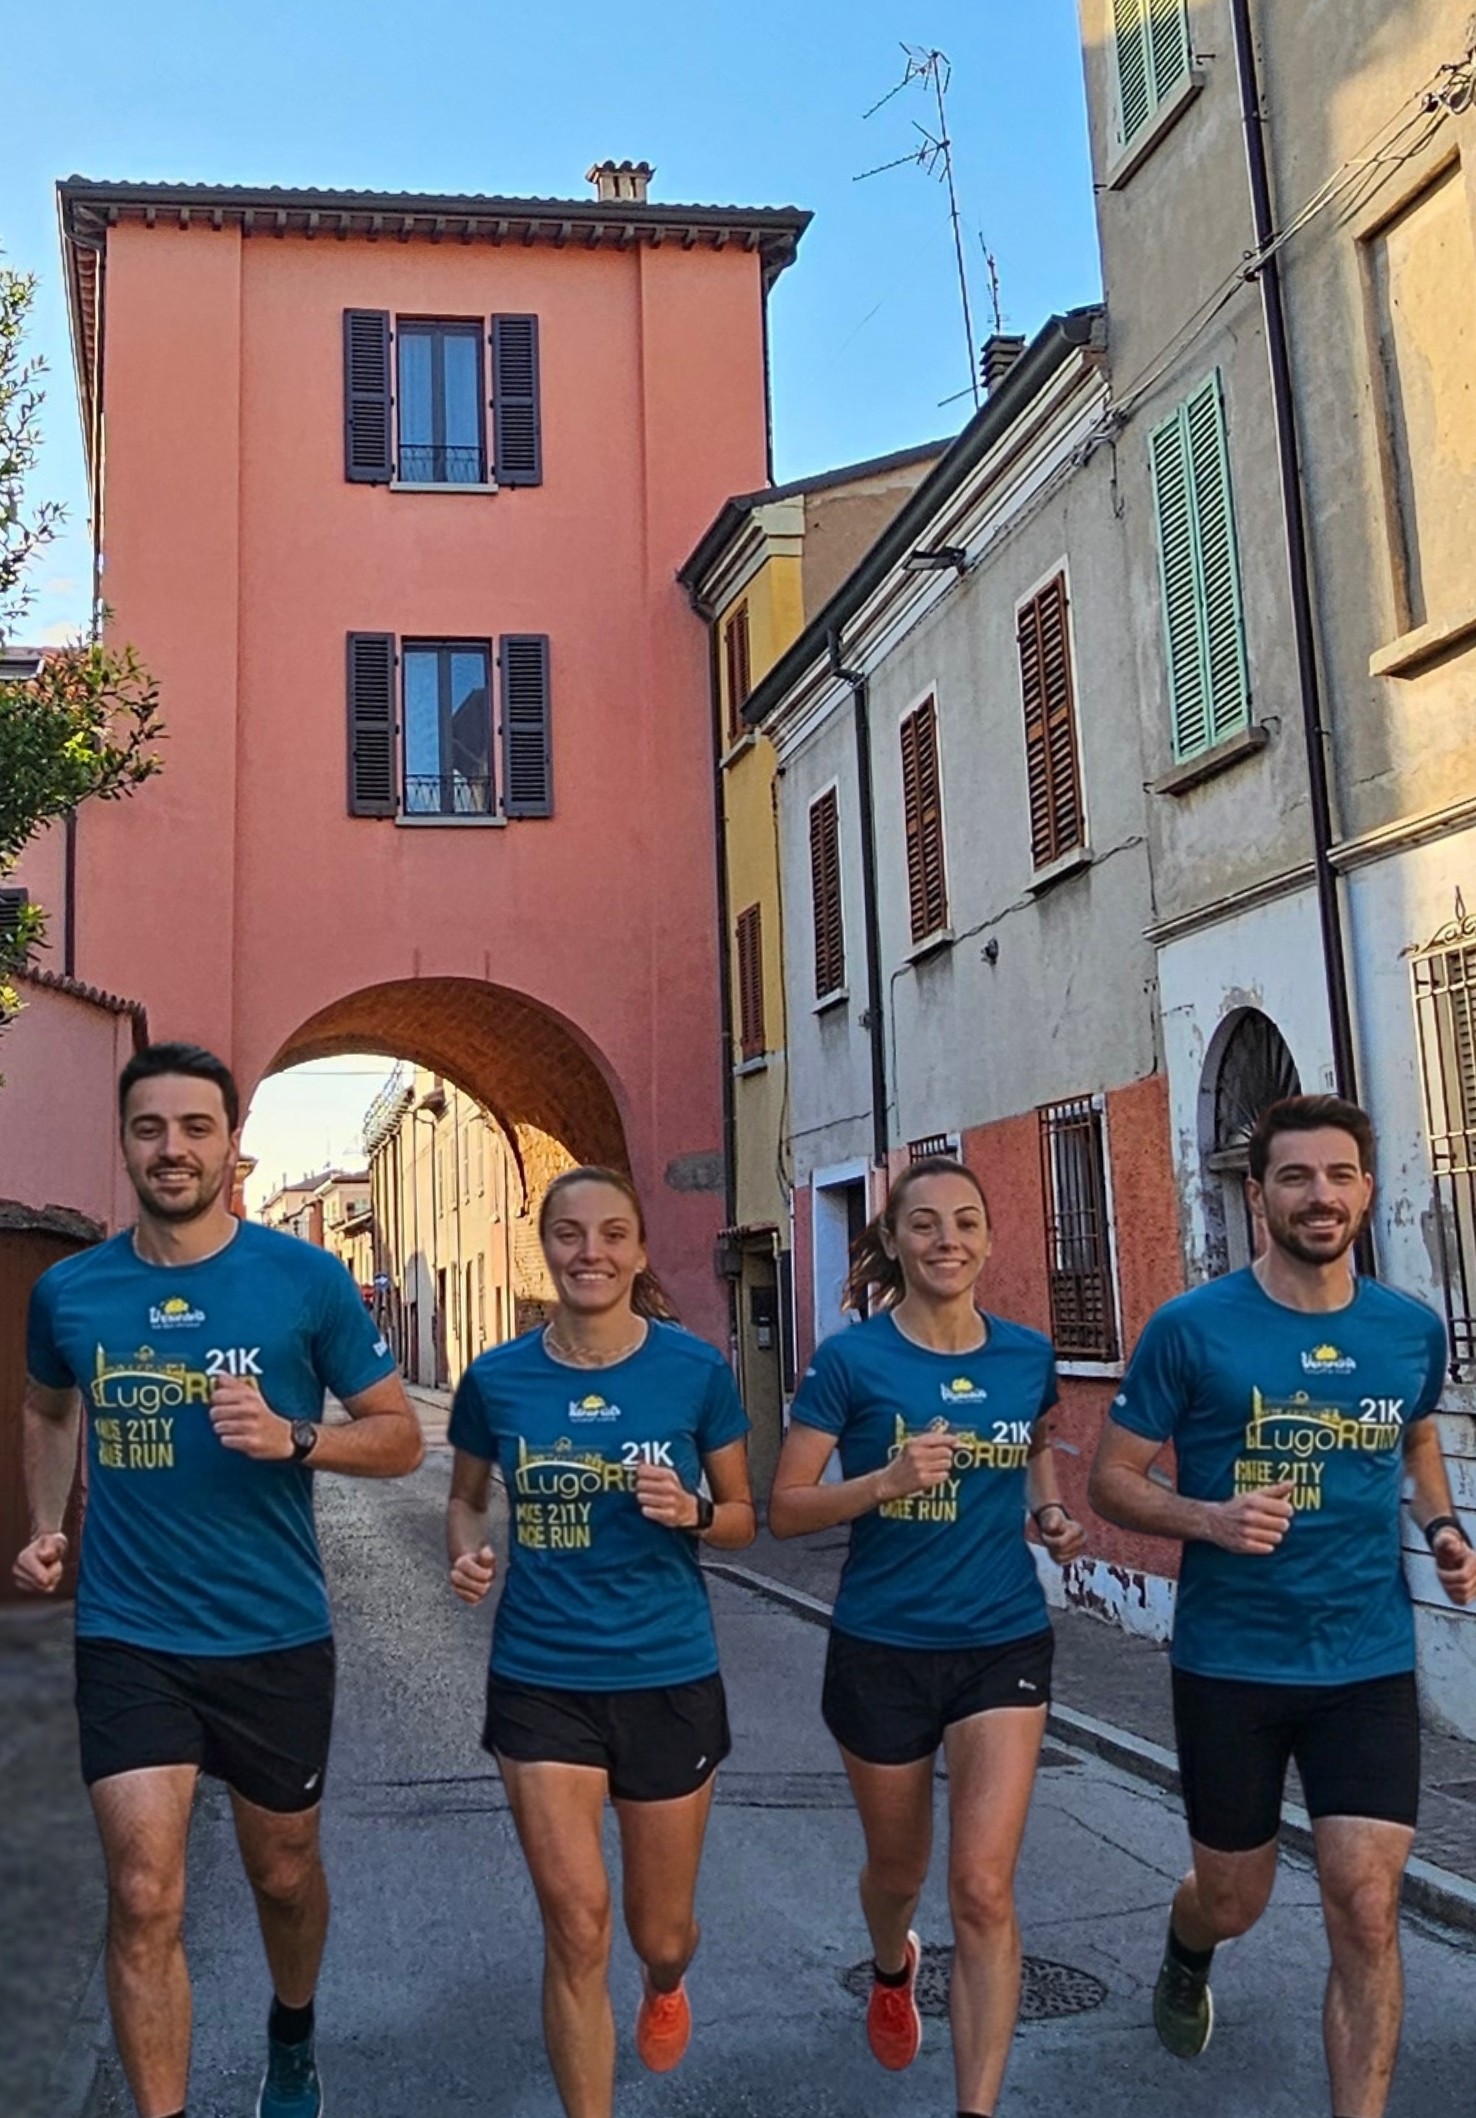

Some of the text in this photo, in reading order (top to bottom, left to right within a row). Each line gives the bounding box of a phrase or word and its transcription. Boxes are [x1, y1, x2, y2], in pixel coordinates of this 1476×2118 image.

[205, 1347, 263, 1376] 21K
[1359, 1398, 1404, 1424] 21K
[991, 1420, 1032, 1445] 21K
[129, 1443, 174, 1469] RUN
[621, 1440, 674, 1467] 21K
[918, 1500, 957, 1522] RUN
[550, 1525, 591, 1549] RUN
